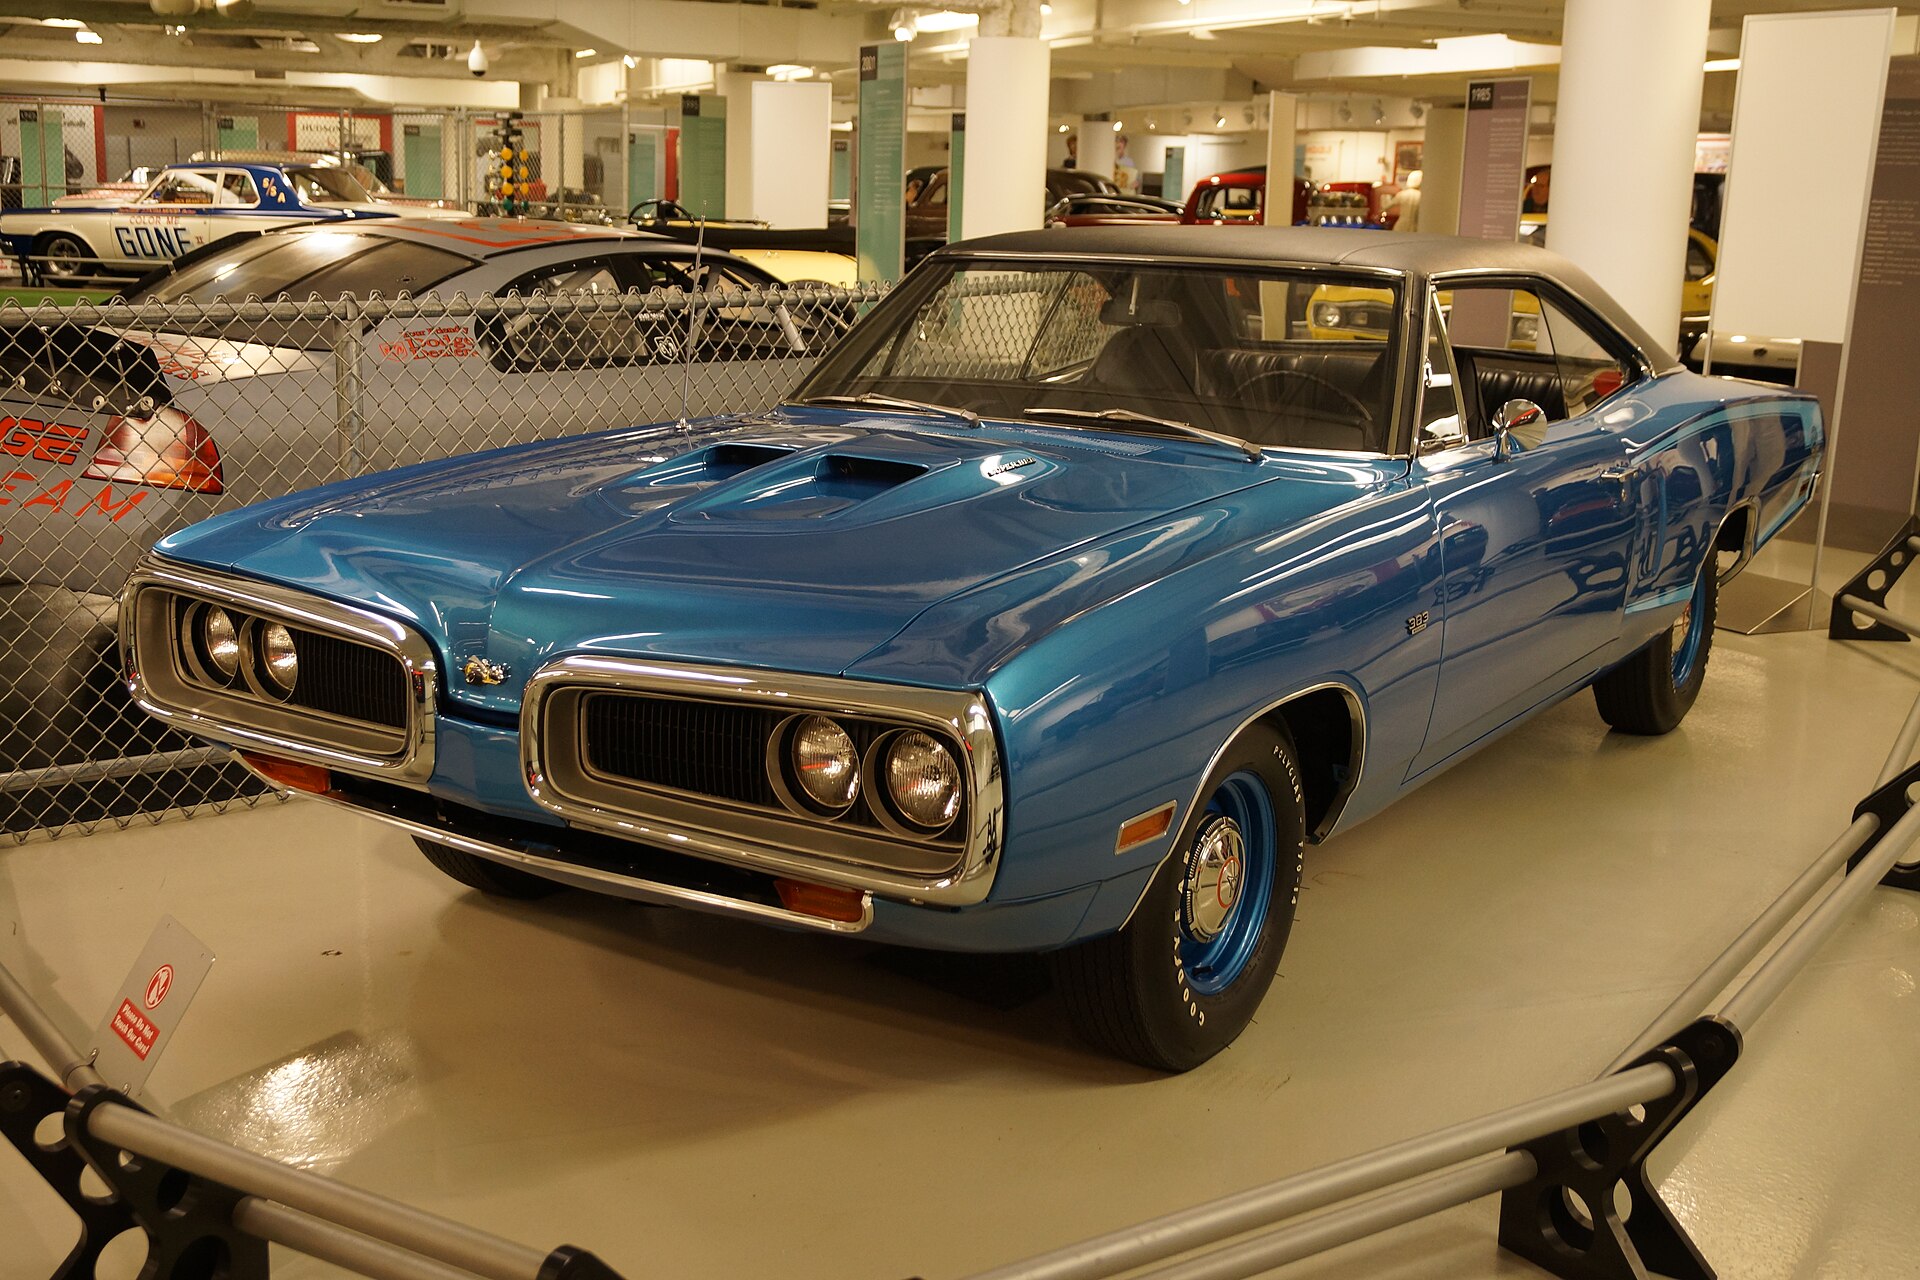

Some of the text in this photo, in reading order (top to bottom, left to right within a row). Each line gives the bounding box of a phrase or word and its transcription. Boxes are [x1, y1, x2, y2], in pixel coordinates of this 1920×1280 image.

[130, 216, 161, 225] COLOR
[426, 324, 469, 335] Fiendy
[405, 334, 475, 349] Dodge
[1409, 611, 1428, 630] 383
[1274, 745, 1301, 803] POLYGLAS
[122, 1003, 154, 1040] Please Do Not
[114, 1014, 150, 1054] Touch Our Cars!
